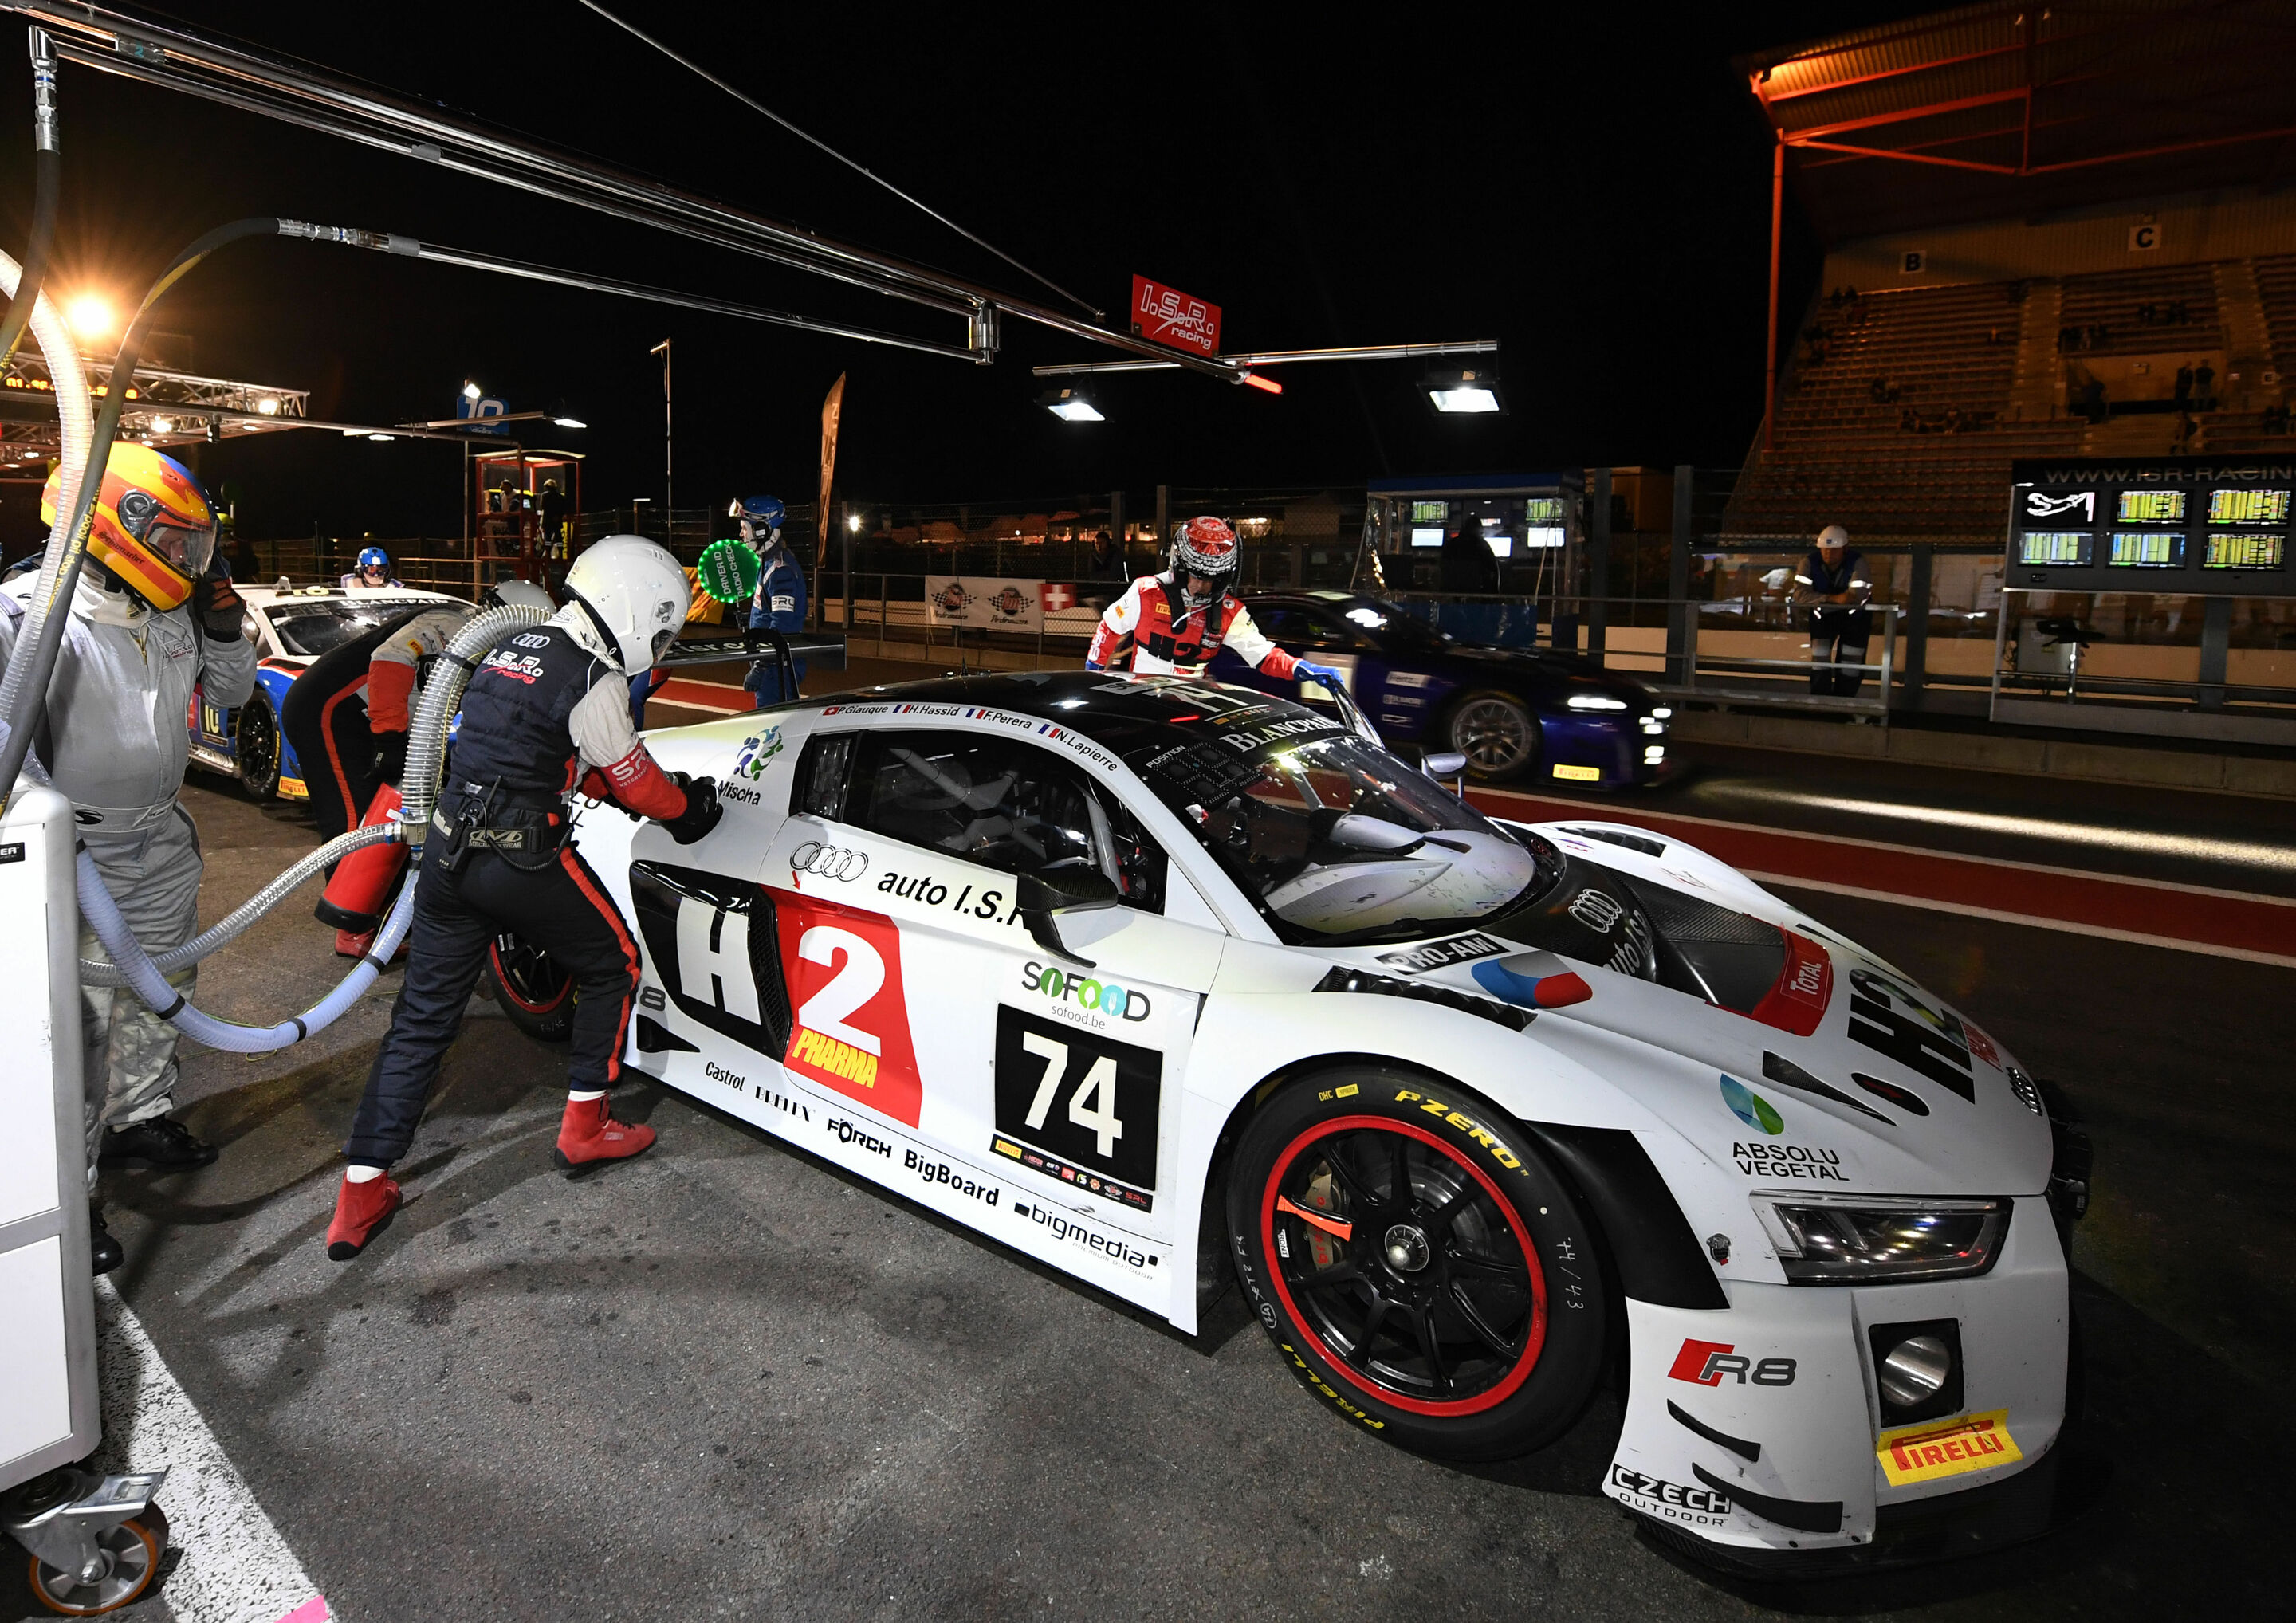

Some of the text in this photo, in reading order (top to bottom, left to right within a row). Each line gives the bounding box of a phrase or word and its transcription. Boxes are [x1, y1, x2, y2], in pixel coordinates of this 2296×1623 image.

[2136, 227, 2154, 249] C
[1905, 253, 1921, 271] B
[1170, 326, 1213, 350] racing
[466, 397, 504, 426] 10
[2044, 466, 2296, 484] WWW.ISR-RACIN
[714, 552, 731, 595] DRIVER ID
[724, 542, 745, 597] RADIO CHECK
[837, 704, 889, 716] P.Giauque
[910, 705, 959, 717] H.Hassid
[985, 709, 1032, 729] F.Perera
[1218, 714, 1341, 753] BLANCPAIN
[1056, 729, 1118, 772] N.Lapierre
[1146, 745, 1187, 768] POSITION
[717, 780, 761, 806] Mischa
[877, 871, 948, 906] auto
[1388, 937, 1499, 970] PRO-AM
[1789, 960, 1822, 996] TOTAL
[1051, 1004, 1107, 1031] sofood.be
[792, 1028, 879, 1090] PHARMA
[705, 1061, 745, 1092] Castrol
[1022, 1030, 1123, 1159] 74
[1318, 1089, 1334, 1102] DHC
[997, 1142, 1020, 1157] PIRELLI
[1732, 1142, 1841, 1165] ABSOLU
[903, 1149, 1000, 1206] BigBoard
[1736, 1160, 1850, 1182] VEGETAL
[1032, 1204, 1146, 1268] bigmedia
[1565, 1284, 1585, 1309] 43
[1700, 1351, 1797, 1388] R8
[1280, 1342, 1386, 1430] PIRELLI
[1889, 1419, 2004, 1472] PIRELLI
[1615, 1467, 1731, 1514] CZECH
[1619, 1492, 1724, 1527] OUTDOOR
